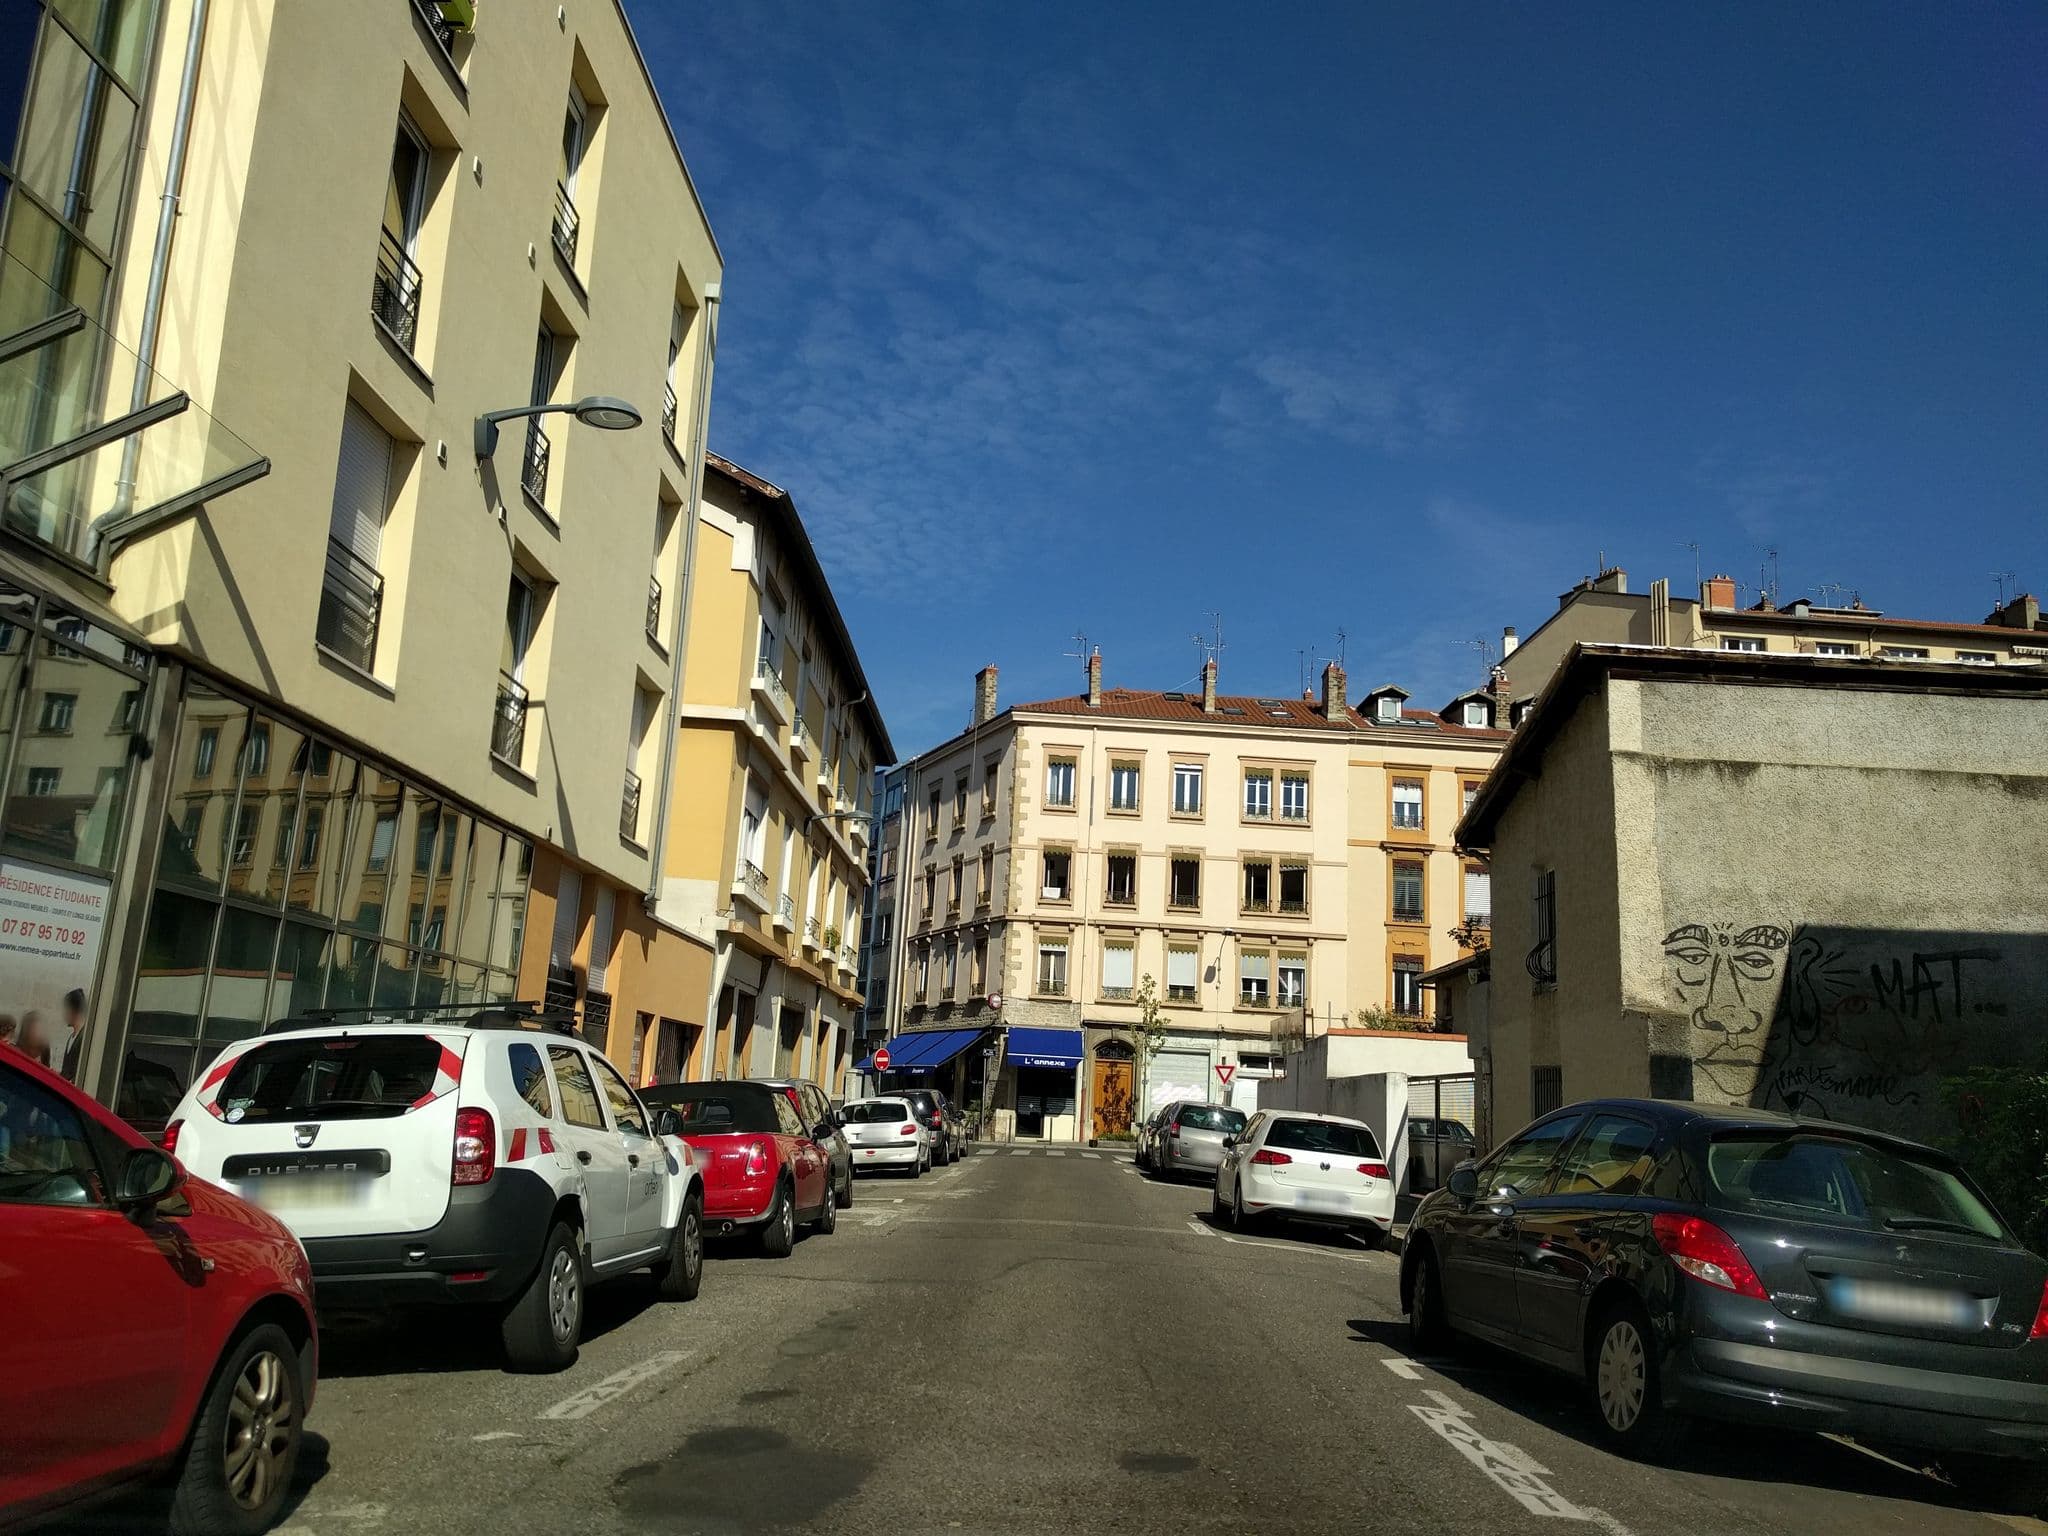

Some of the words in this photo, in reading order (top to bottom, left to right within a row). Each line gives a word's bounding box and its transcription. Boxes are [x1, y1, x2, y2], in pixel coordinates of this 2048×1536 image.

[0, 875, 52, 898] RÉSIDENCE
[54, 884, 101, 908] ÉTUDIANTE
[2, 918, 18, 935] 07
[20, 921, 36, 937] 87
[38, 924, 53, 940] 95
[55, 927, 69, 943] 70
[72, 930, 86, 945] 92
